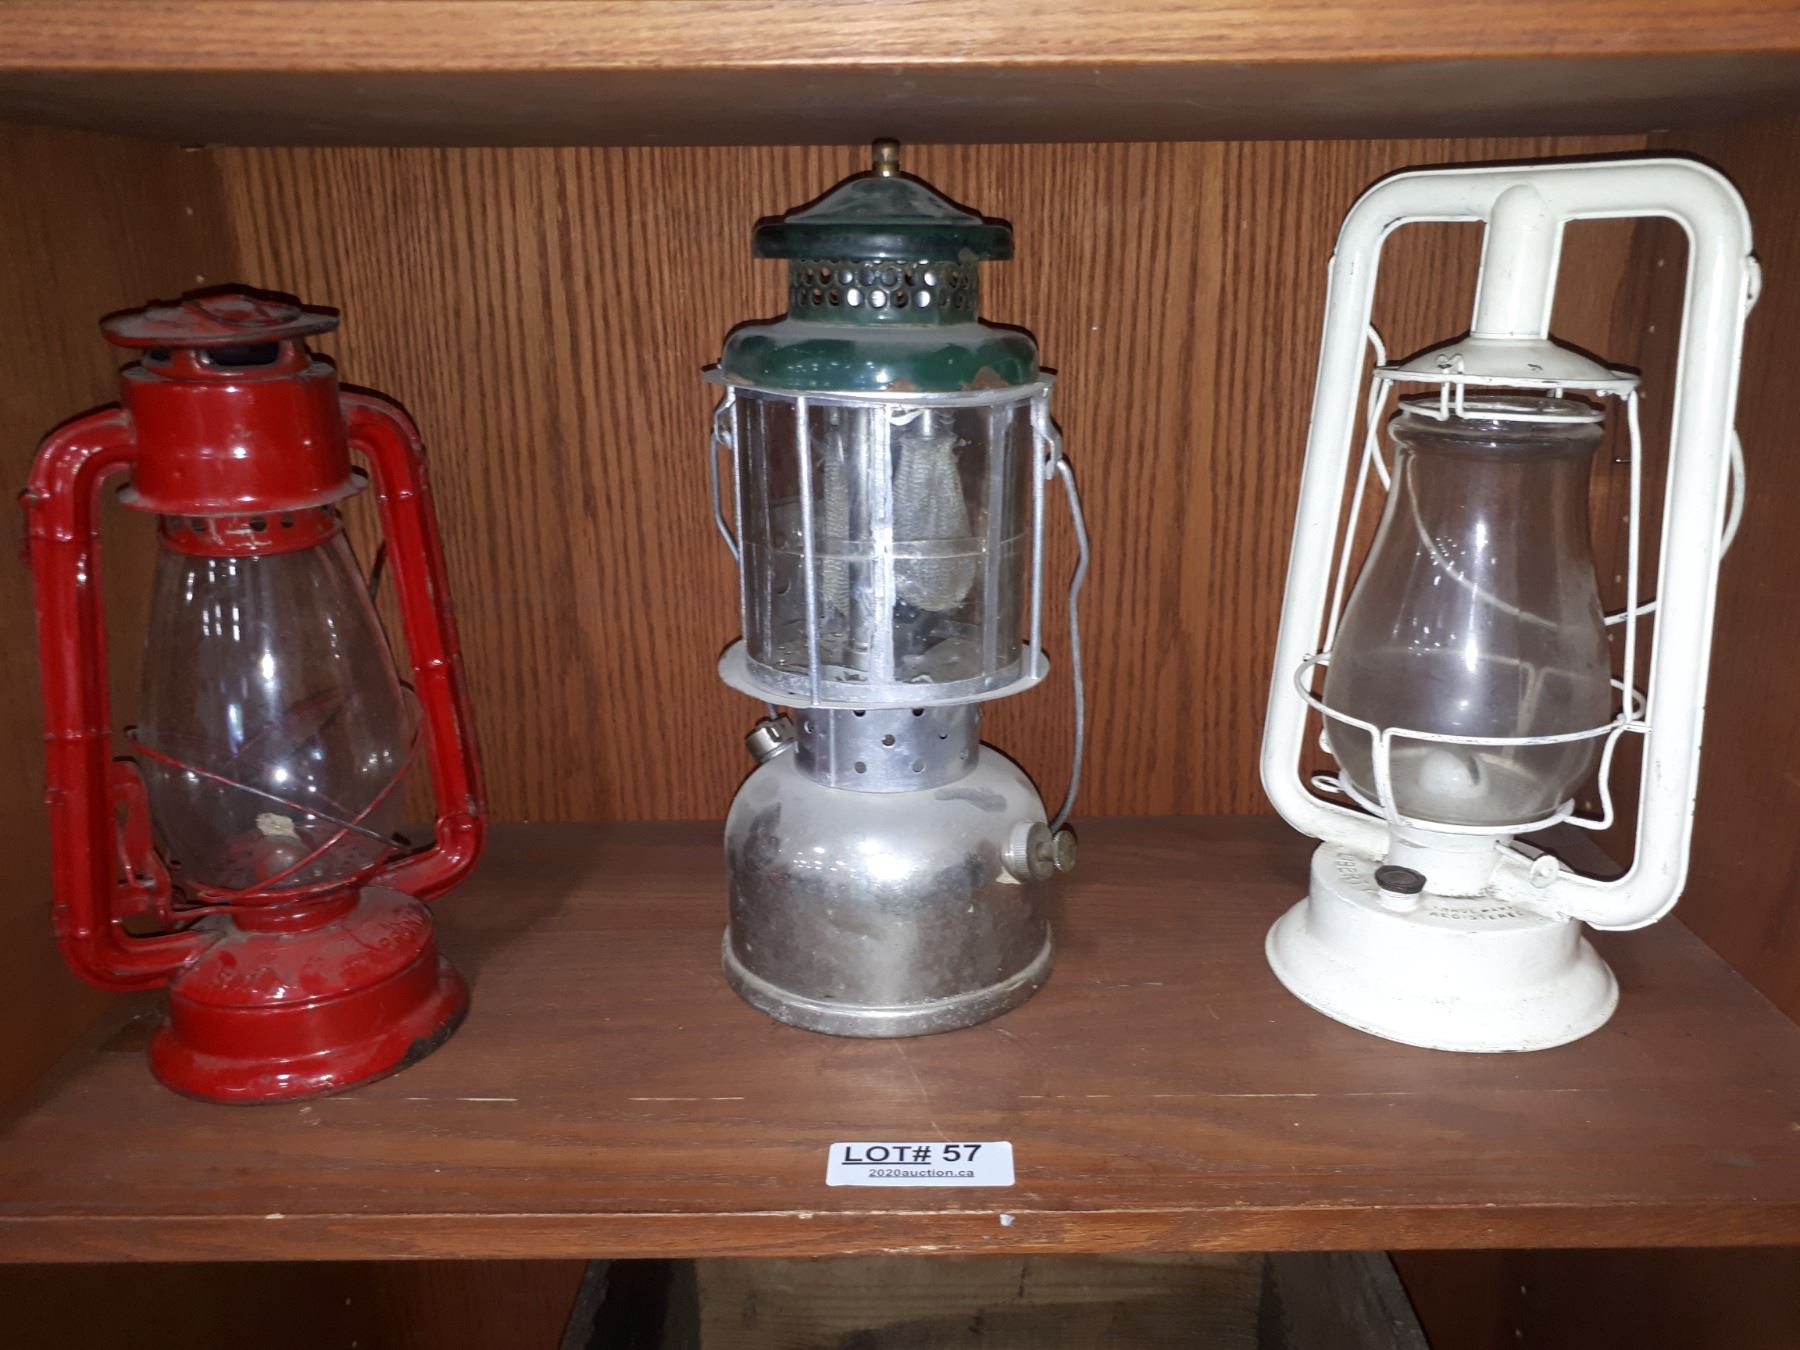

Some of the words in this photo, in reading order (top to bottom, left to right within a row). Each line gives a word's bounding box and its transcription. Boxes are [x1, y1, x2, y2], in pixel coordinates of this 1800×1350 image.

[842, 1145, 932, 1165] LOT#
[942, 1144, 982, 1162] 57
[868, 1168, 975, 1178] 2020auction.ca
